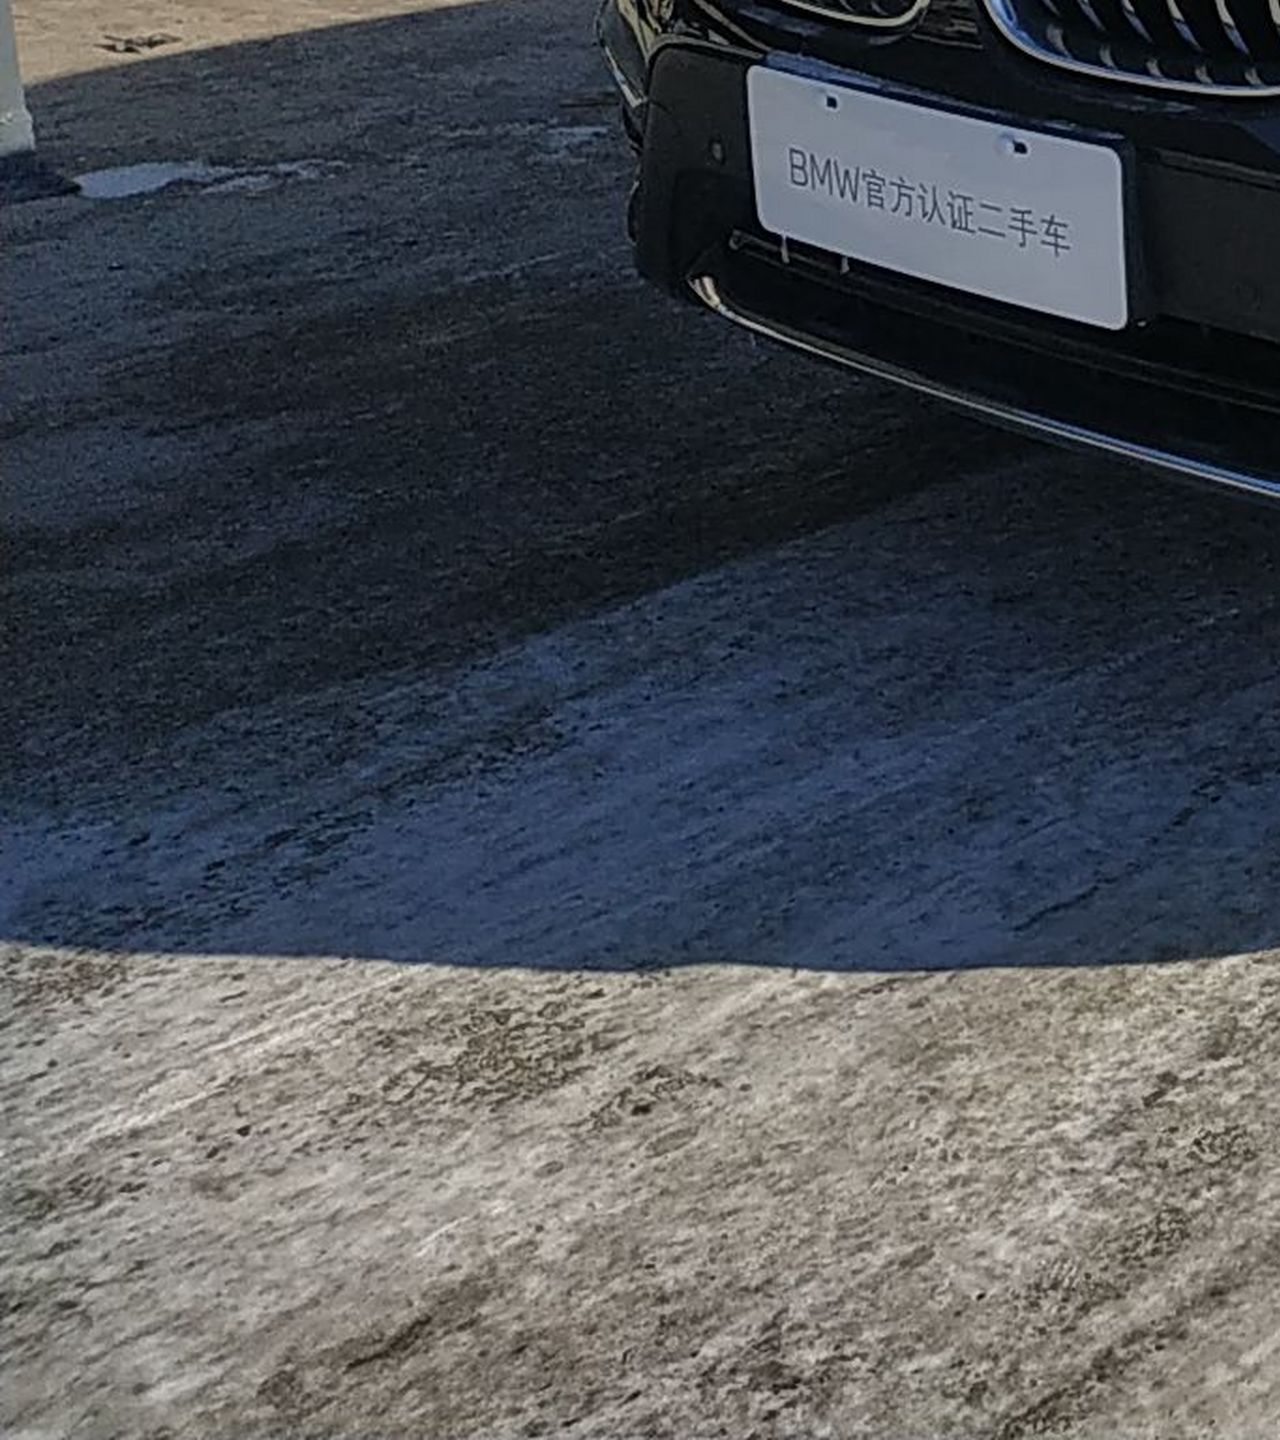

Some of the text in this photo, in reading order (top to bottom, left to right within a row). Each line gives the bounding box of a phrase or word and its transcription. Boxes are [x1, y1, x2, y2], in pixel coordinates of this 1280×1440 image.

[789, 147, 1071, 258] BMW官方认证二手车
